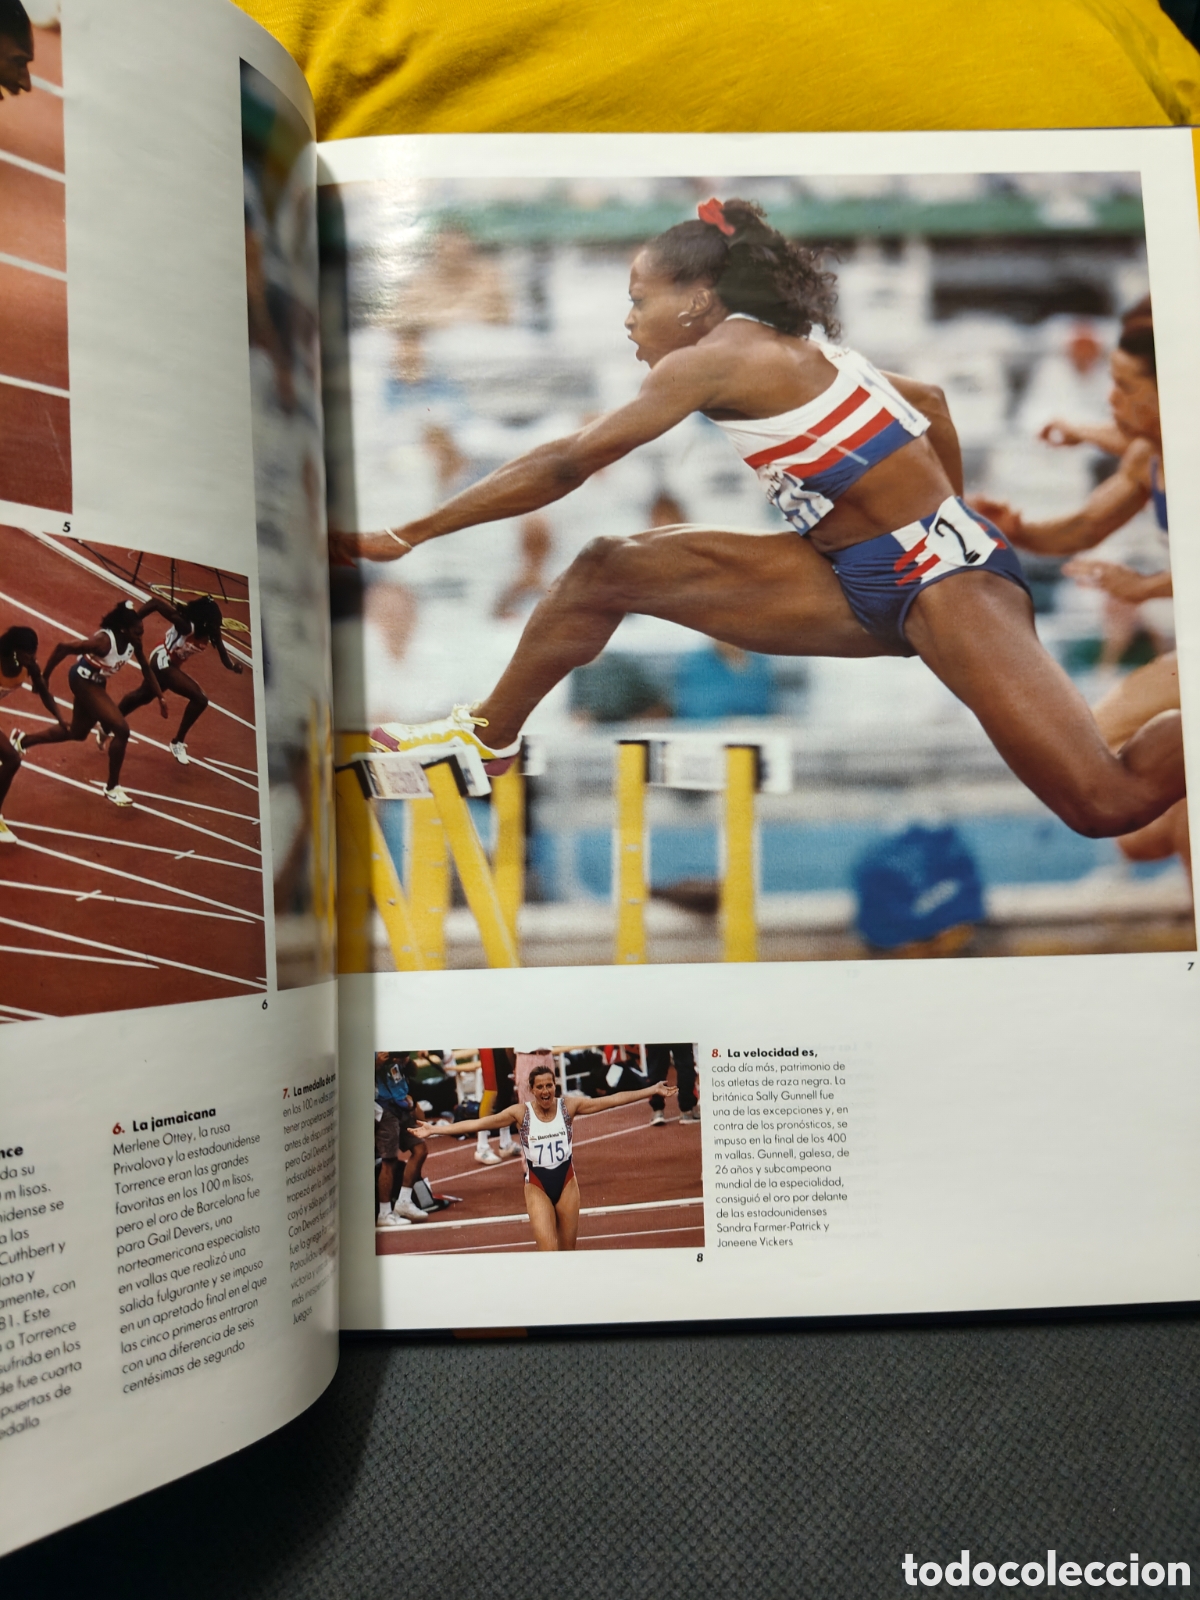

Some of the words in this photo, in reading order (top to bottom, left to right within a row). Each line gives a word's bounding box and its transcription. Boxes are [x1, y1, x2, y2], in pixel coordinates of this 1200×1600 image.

[62, 521, 71, 533] 5
[934, 517, 981, 564] 2
[1187, 961, 1195, 971] 7
[261, 999, 268, 1010] 6
[711, 1048, 722, 1059] 8.
[727, 1048, 741, 1058] La
[743, 1046, 800, 1058] velocidad
[801, 1049, 818, 1058] es,
[711, 1062, 736, 1073] cada
[738, 1062, 754, 1073] día
[755, 1062, 778, 1073] más,
[780, 1062, 831, 1074] patrimonio
[832, 1061, 846, 1071] de
[711, 1077, 726, 1088] los
[727, 1077, 760, 1088] atletas
[761, 1076, 775, 1087] de
[801, 1078, 832, 1088] negra.
[834, 1075, 846, 1085] La
[282, 1087, 290, 1099] 7.
[293, 1086, 302, 1097] La
[712, 1091, 754, 1102] británica
[756, 1090, 779, 1103] Sally
[780, 1089, 818, 1101] Gunnell
[819, 1089, 835, 1100] fue
[283, 1107, 292, 1118] en
[292, 1102, 302, 1114] los
[302, 1097, 314, 1110] 100
[712, 1109, 731, 1117] una
[732, 1106, 745, 1116] de
[747, 1106, 761, 1116] las
[762, 1106, 823, 1117] excepciones
[825, 1107, 834, 1116] y,
[836, 1106, 849, 1114] en
[111, 1122, 126, 1136] 6.
[132, 1120, 149, 1133] La
[150, 1108, 217, 1133] jamaicana
[713, 1122, 744, 1131] contra
[745, 1120, 759, 1131] de
[760, 1120, 775, 1130] los
[776, 1119, 835, 1132] pronósticos,
[837, 1121, 848, 1129] se
[112, 1138, 160, 1156] Merlene
[162, 1132, 197, 1146] Ottey,
[198, 1126, 208, 1138] la
[210, 1123, 231, 1136] rusa
[714, 1136, 747, 1148] impuso
[749, 1137, 761, 1145] en
[763, 1134, 772, 1145] la
[774, 1133, 795, 1144] final
[796, 1133, 809, 1144] de
[810, 1133, 825, 1144] los
[827, 1132, 847, 1143] 400
[113, 1157, 166, 1176] Privalova
[166, 1155, 174, 1167] y
[175, 1150, 186, 1162] la
[187, 1134, 261, 1160] estadounidense
[534, 1140, 565, 1165] 715
[724, 1149, 755, 1160] vallas.
[757, 1148, 797, 1159] Gunnell,
[799, 1147, 835, 1161] galesa,
[836, 1147, 850, 1158] de
[114, 1176, 166, 1195] Torrence
[167, 1169, 193, 1183] eran
[194, 1164, 209, 1177] las
[210, 1154, 249, 1176] grandes
[715, 1164, 729, 1175] 26
[730, 1165, 754, 1175] años
[755, 1166, 762, 1176] y
[764, 1163, 832, 1175] subcampeona
[19, 1184, 51, 1197] lisos.
[715, 1178, 752, 1189] mundial
[753, 1178, 767, 1189] de
[768, 1178, 778, 1189] la
[779, 1176, 844, 1190] especialidad,
[115, 1195, 165, 1215] favoritas
[167, 1191, 181, 1203] en
[182, 1186, 198, 1199] los
[201, 1177, 221, 1194] 100
[222, 1178, 231, 1188] m
[231, 1173, 254, 1185] lisos,
[715, 1193, 761, 1206] consiguió
[762, 1192, 772, 1203] el
[773, 1195, 791, 1203] oro
[792, 1194, 810, 1204] por
[811, 1191, 848, 1202] delante
[50, 1200, 65, 1212] se
[115, 1220, 144, 1239] pero
[146, 1213, 157, 1228] el
[158, 1211, 178, 1224] oro
[180, 1204, 195, 1219] de
[196, 1193, 245, 1214] Barcelona
[246, 1187, 260, 1199] fue
[716, 1207, 729, 1219] de
[731, 1208, 745, 1218] las
[746, 1206, 827, 1218] estadounidenses
[716, 1222, 752, 1233] Sandra
[753, 1220, 821, 1232] Farmer-Patrick
[823, 1223, 830, 1233] y
[11, 1229, 29, 1242] las
[116, 1240, 145, 1258] para
[147, 1228, 171, 1246] Gail
[173, 1222, 213, 1240] Devers,
[214, 1215, 233, 1228] una
[717, 1238, 758, 1248] Janeene
[759, 1236, 794, 1247] Vickers
[117, 1242, 205, 1275] norteamericana
[206, 1225, 261, 1249] especialista
[696, 1253, 704, 1263] 8
[118, 1282, 133, 1295] en
[135, 1272, 168, 1289] vallas
[170, 1266, 191, 1281] que
[192, 1251, 228, 1273] realizó
[229, 1248, 246, 1261] una
[119, 1294, 154, 1315] salida
[156, 1279, 210, 1303] fulgurante
[211, 1276, 218, 1288] y
[220, 1271, 231, 1283] se
[232, 1260, 264, 1278] impuso
[119, 1322, 135, 1335] en
[136, 1317, 151, 1329] un
[152, 1297, 204, 1325] apretado
[206, 1288, 227, 1306] final
[228, 1287, 240, 1298] en
[241, 1279, 250, 1293] el
[251, 1276, 267, 1291] que
[24, 1307, 51, 1324] Este
[293, 1306, 313, 1325] Juegos
[19, 1321, 77, 1347] Torrence
[120, 1341, 138, 1354] las
[140, 1331, 170, 1348] cinco
[172, 1314, 218, 1341] primeras
[219, 1298, 258, 1321] entraron
[63, 1340, 81, 1354] los
[121, 1359, 144, 1375] con
[145, 1352, 167, 1366] una
[168, 1332, 221, 1358] diferencia
[222, 1324, 236, 1338] de
[237, 1318, 255, 1333] seis
[41, 1361, 82, 1382] cuarta
[122, 1364, 185, 1394] centésimas
[186, 1357, 201, 1371] de
[203, 1340, 245, 1365] segundo
[0, 1392, 52, 1420] puertas
